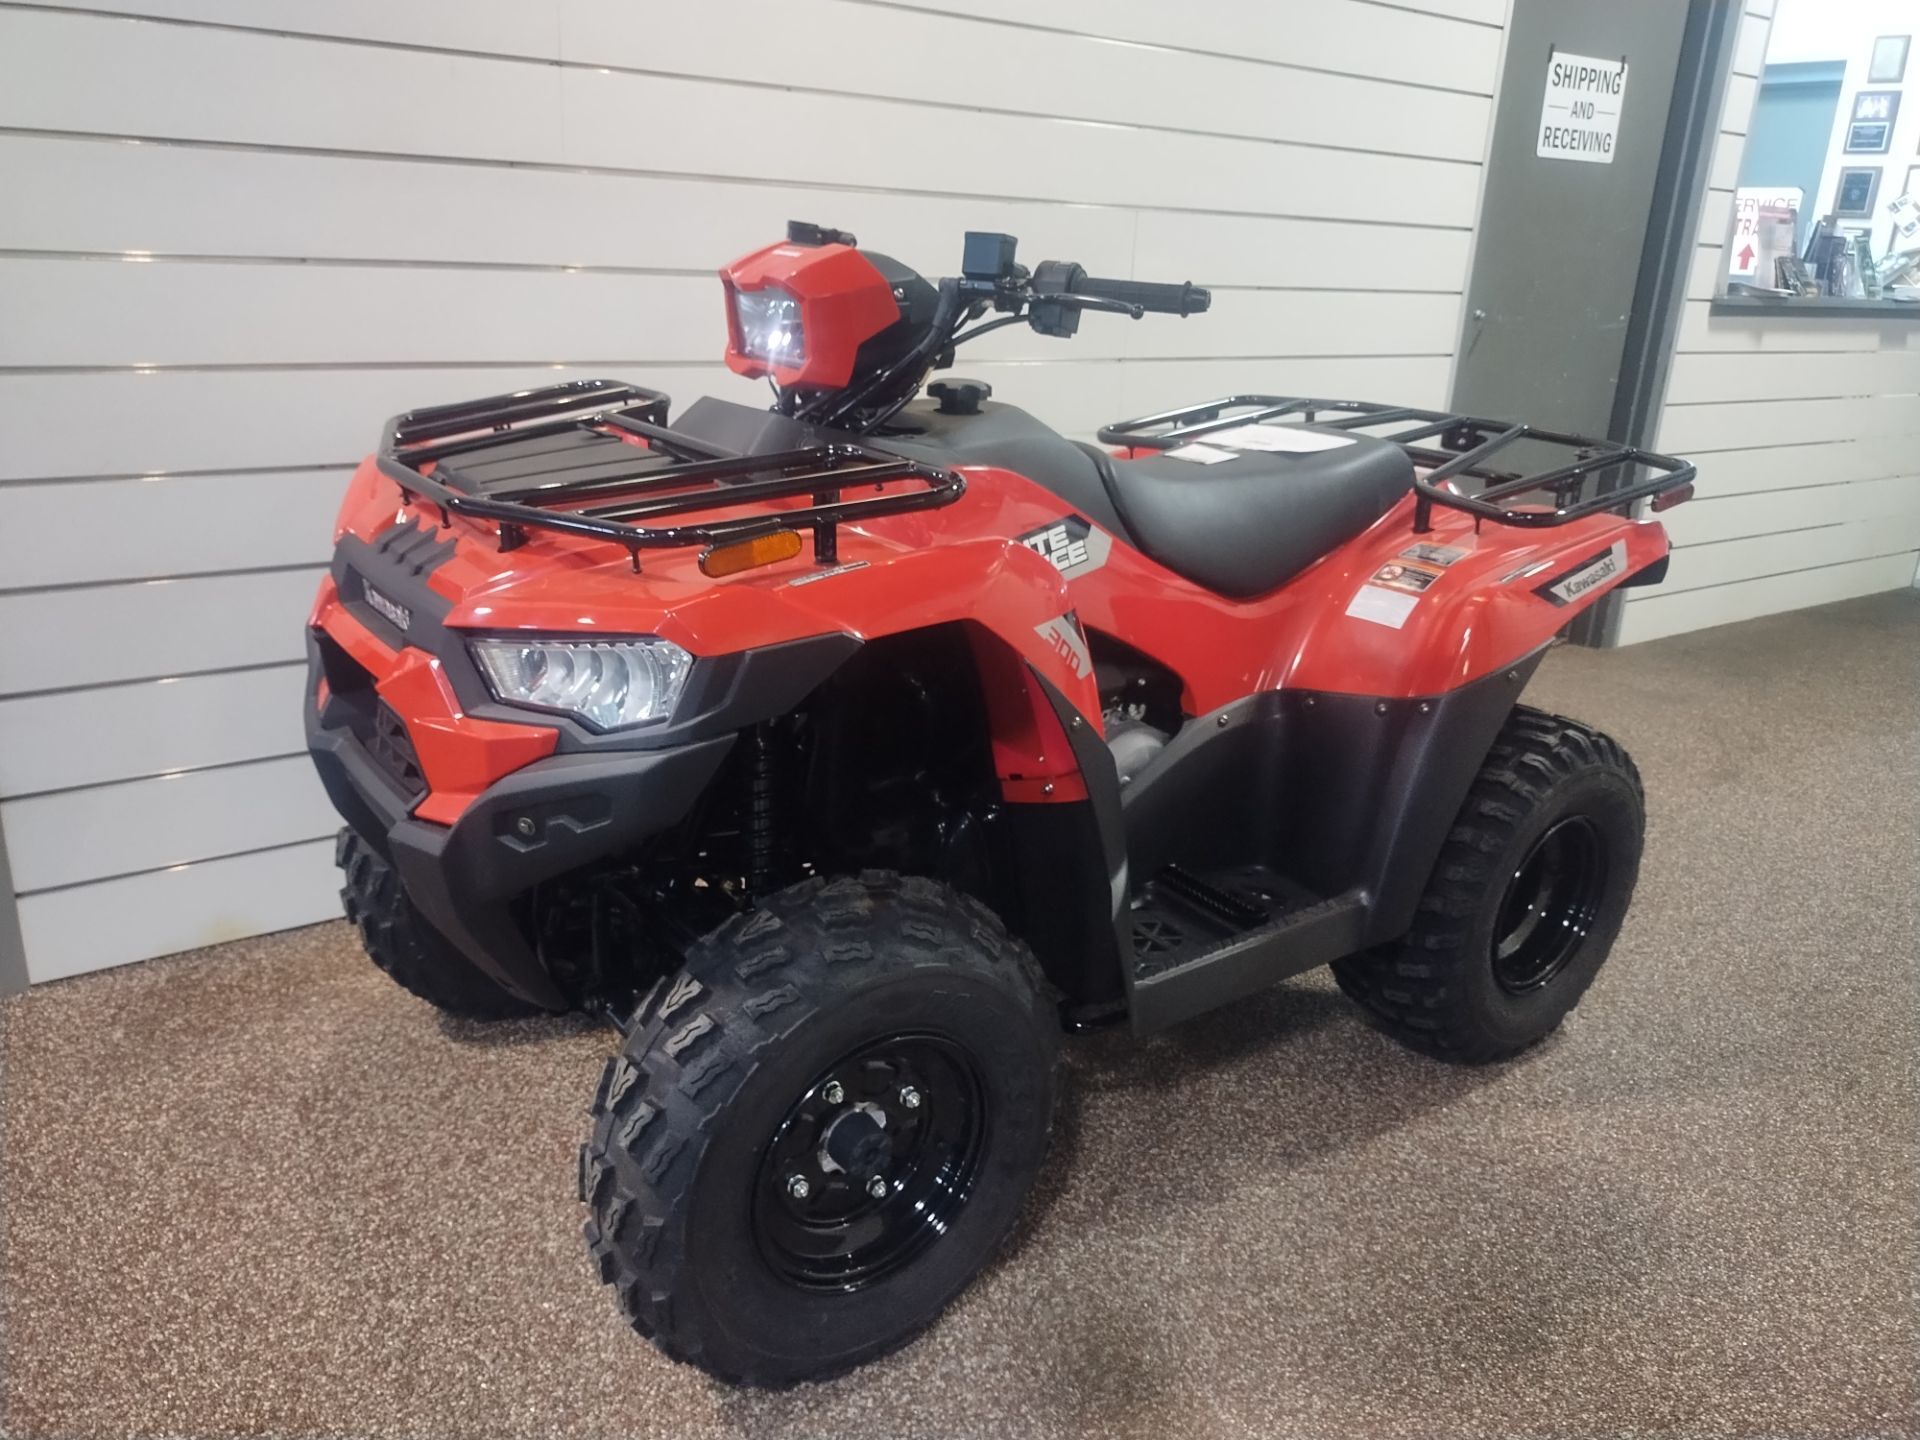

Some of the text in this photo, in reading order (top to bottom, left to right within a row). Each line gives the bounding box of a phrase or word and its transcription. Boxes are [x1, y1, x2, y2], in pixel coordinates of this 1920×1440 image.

[1552, 63, 1621, 94] SHIPPING
[1570, 101, 1594, 120] AND
[1542, 126, 1612, 153] RECEIVING
[1023, 524, 1069, 556] TE
[1044, 539, 1088, 571] CE
[1563, 559, 1616, 598] Kawasaki
